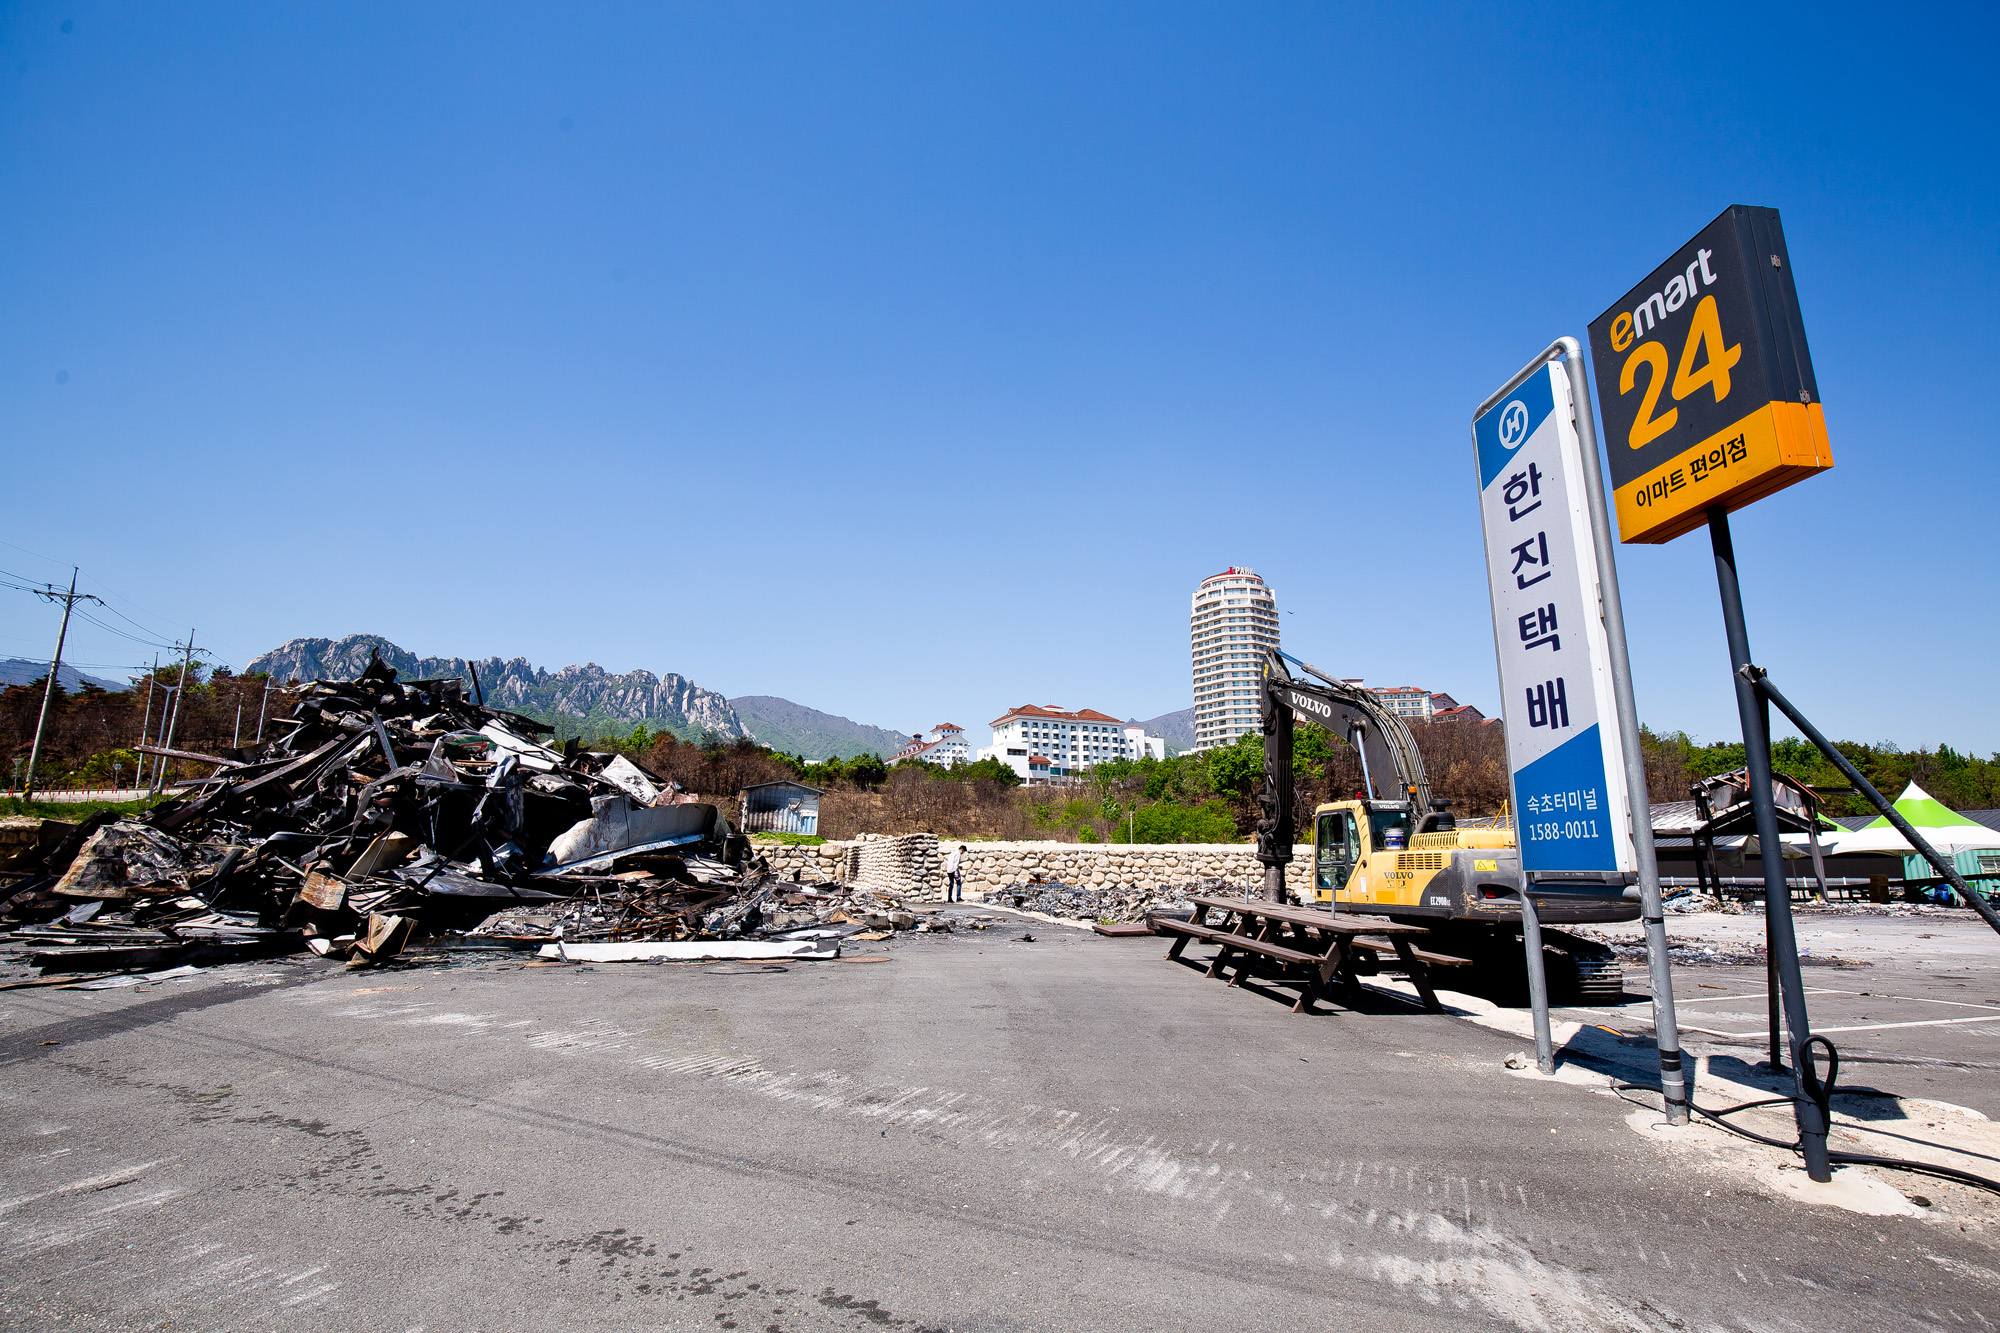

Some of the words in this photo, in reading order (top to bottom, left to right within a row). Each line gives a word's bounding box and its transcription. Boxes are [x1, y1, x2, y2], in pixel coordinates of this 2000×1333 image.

[1610, 248, 1717, 352] emart
[1619, 295, 1742, 450] 24
[1635, 468, 1687, 508] 이마트
[1690, 433, 1748, 483] 편의점
[1502, 461, 1570, 730] 한진택배
[1290, 691, 1331, 718] VOLVO
[1527, 787, 1598, 815] 속초터미널
[1529, 819, 1599, 841] 1588-0011
[1383, 871, 1414, 880] VOLVO
